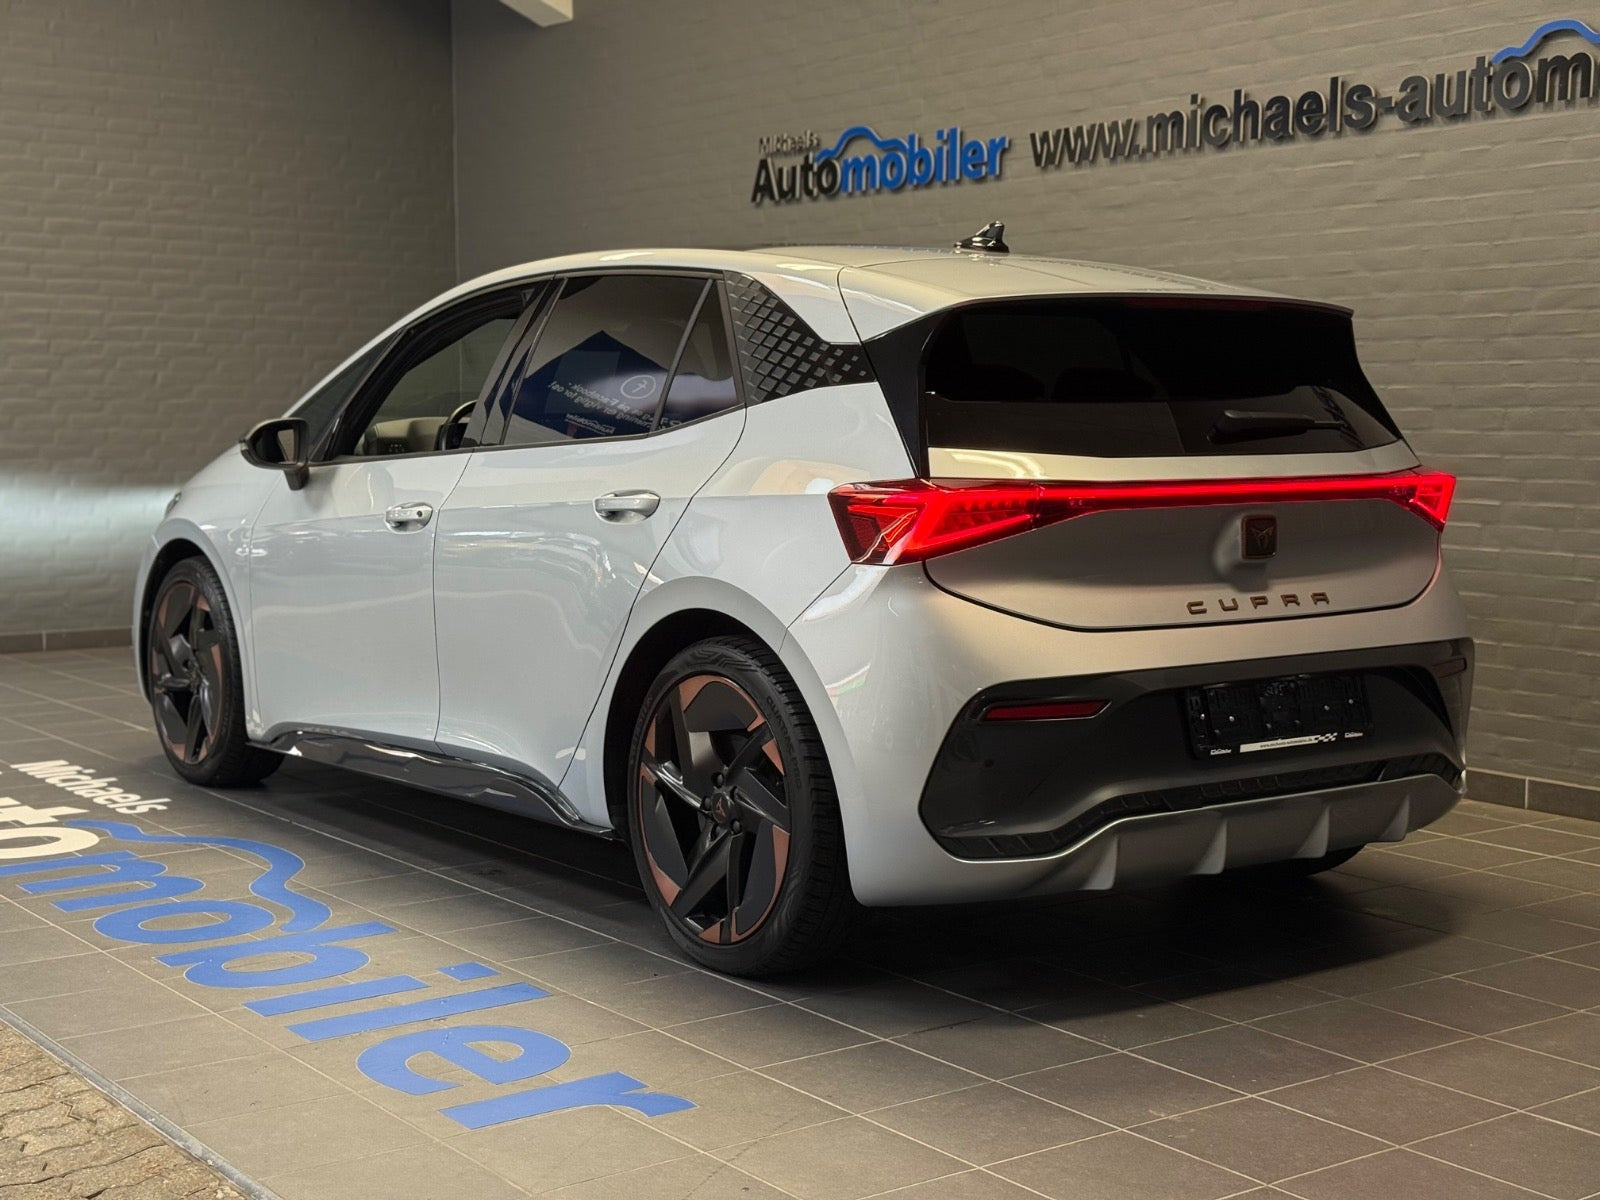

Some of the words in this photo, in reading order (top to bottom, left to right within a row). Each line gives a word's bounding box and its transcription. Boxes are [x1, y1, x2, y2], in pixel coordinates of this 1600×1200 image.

[758, 129, 821, 154] Michaels
[1030, 52, 1600, 168] www.michaels-autom
[751, 127, 1009, 202] Automobiler
[1186, 591, 1330, 615] CUPRA
[10, 759, 172, 814] Michaels
[0, 797, 699, 1131] tomobiler
